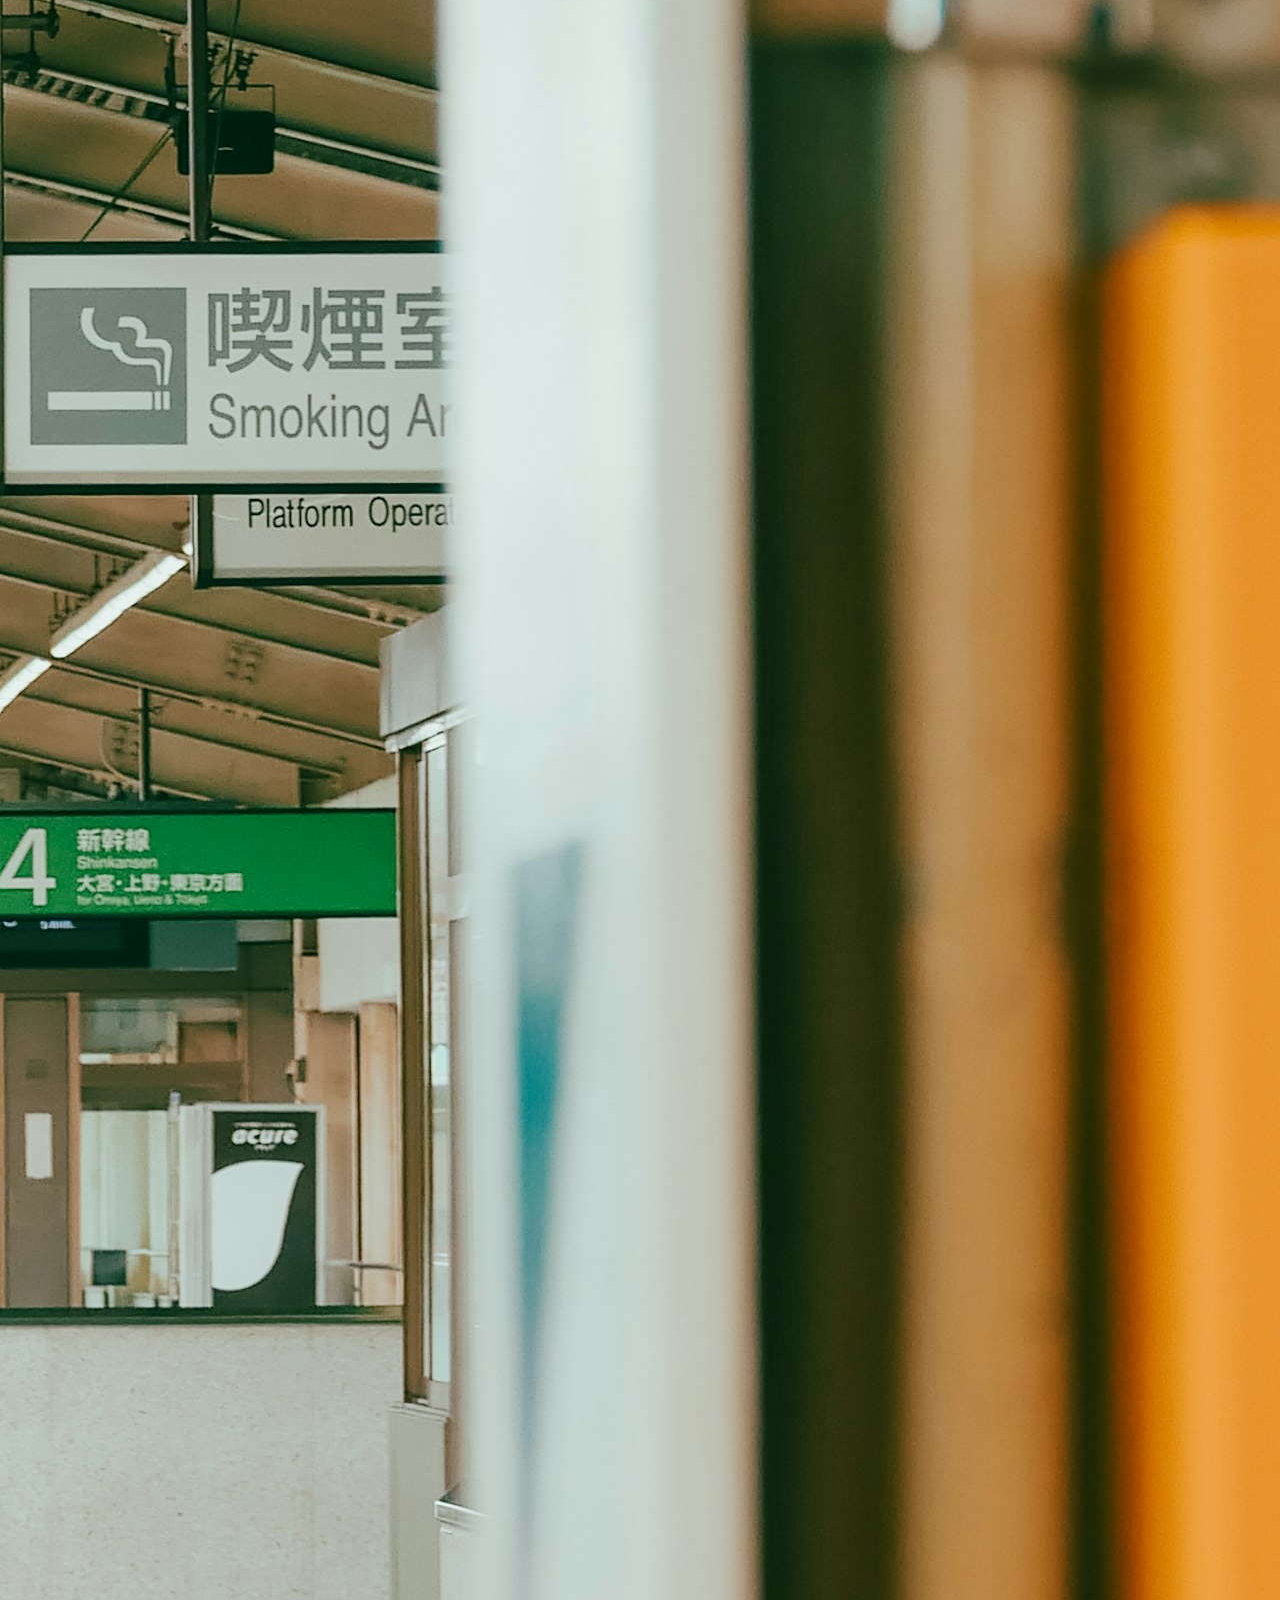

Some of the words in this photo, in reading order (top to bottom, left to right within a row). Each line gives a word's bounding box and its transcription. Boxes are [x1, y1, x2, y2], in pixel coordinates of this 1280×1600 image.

[207, 286, 454, 373] 喫煙室
[208, 392, 390, 450] Smoking
[406, 393, 458, 438] Ar
[248, 497, 354, 529] Platform
[76, 828, 150, 852] 新幹線
[76, 855, 159, 870] Shinkansen
